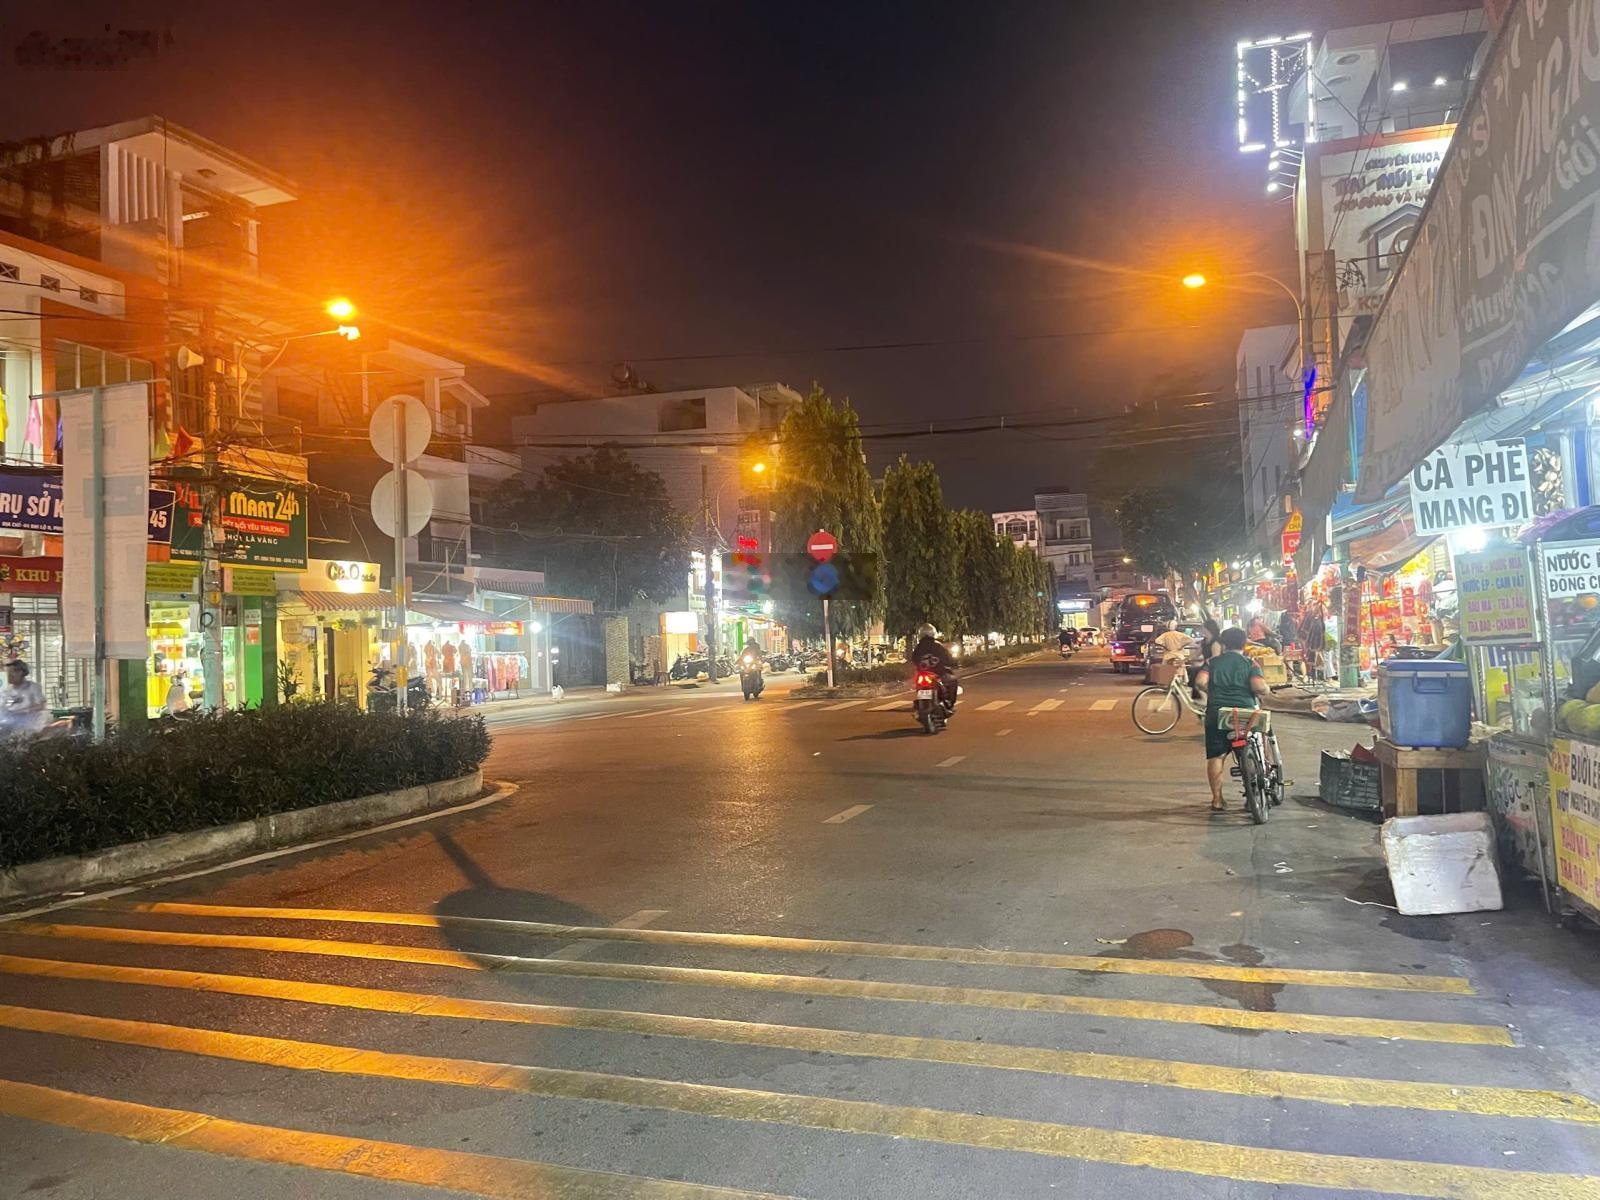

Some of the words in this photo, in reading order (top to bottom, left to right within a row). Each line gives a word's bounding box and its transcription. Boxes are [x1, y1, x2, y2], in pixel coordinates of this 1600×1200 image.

[1413, 449, 1454, 492] CÀ
[1464, 444, 1526, 487] PHÊ
[27, 490, 51, 518] SỞ
[274, 490, 300, 520] 24h
[1419, 495, 1495, 530] MANG
[1501, 491, 1529, 521] ĐI
[150, 510, 167, 528] 45
[246, 534, 255, 543] LÀ
[1546, 550, 1591, 572] NƯỚC
[15, 568, 50, 582] KHU
